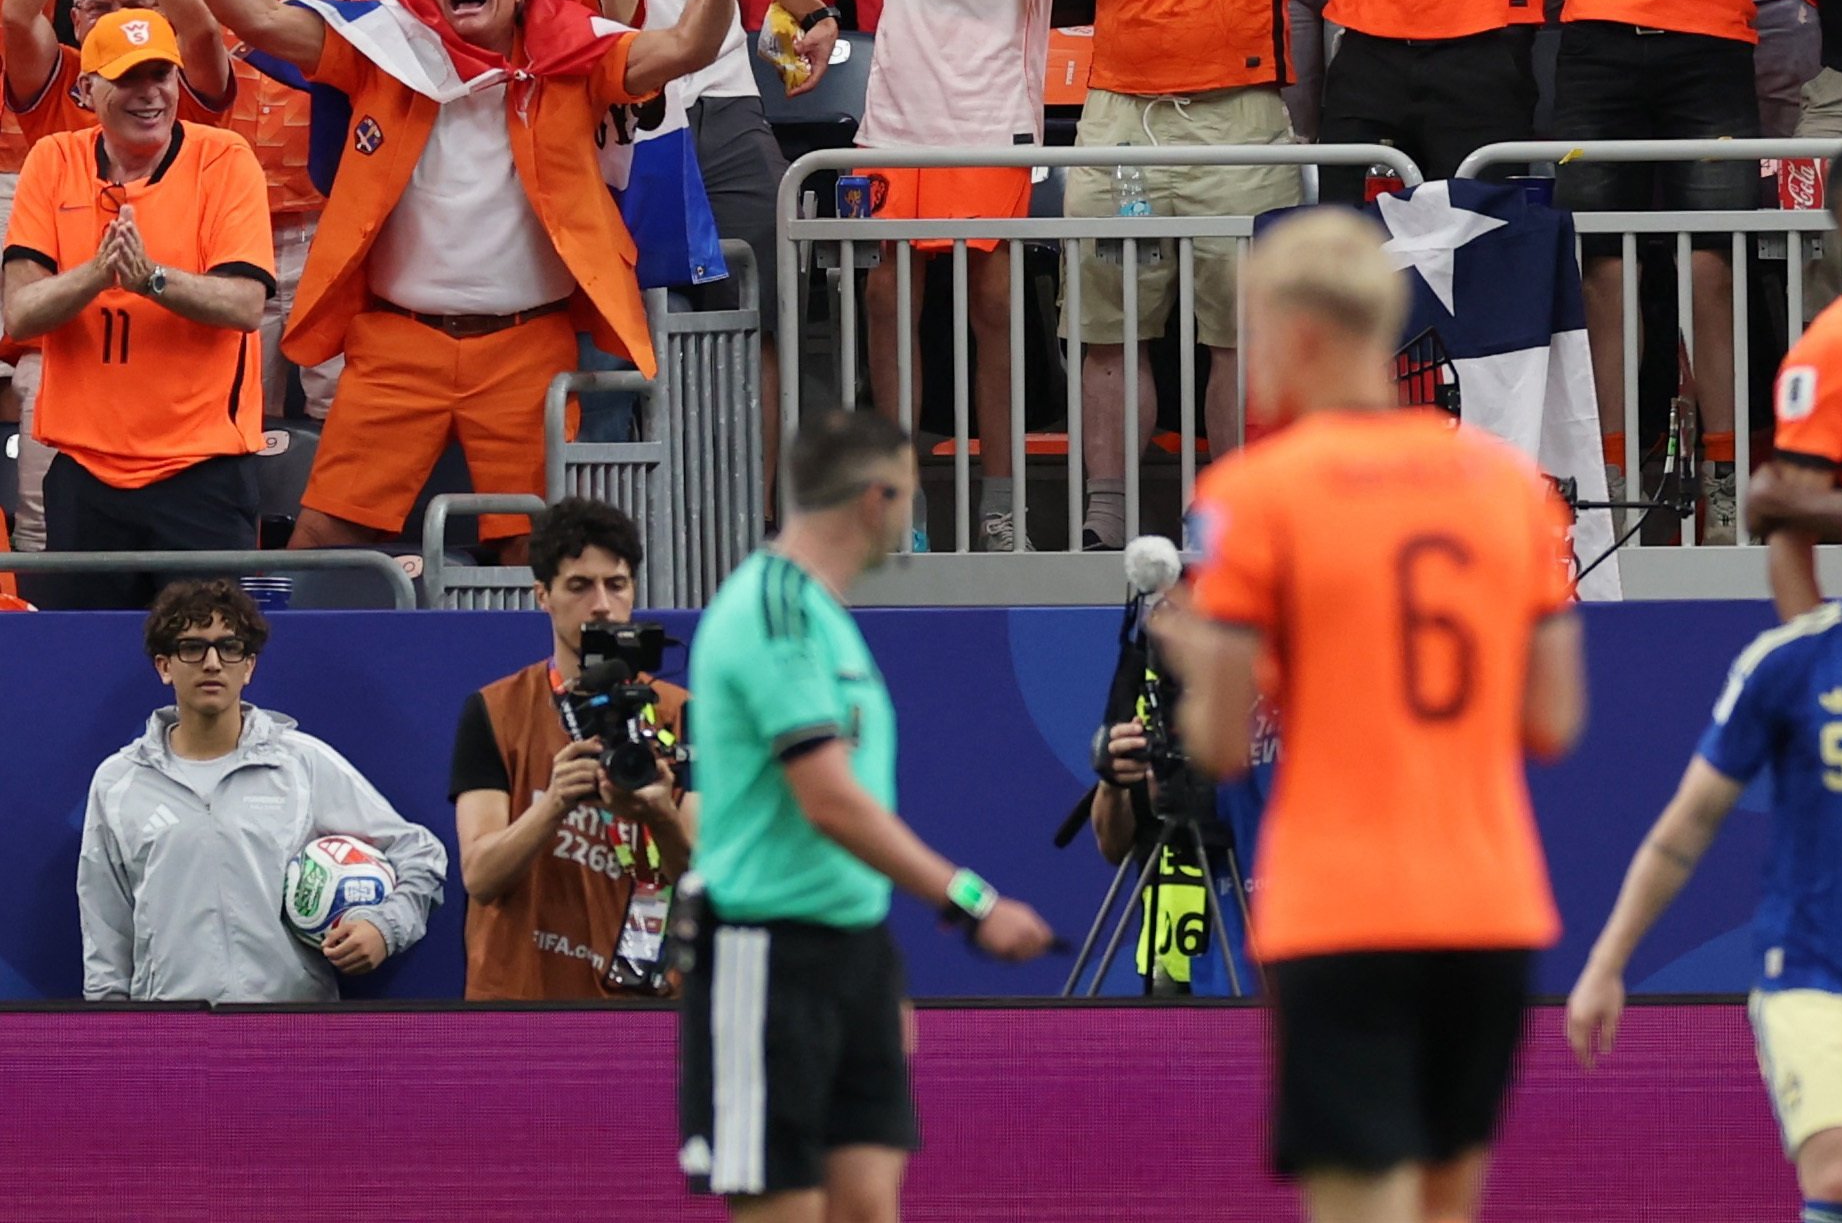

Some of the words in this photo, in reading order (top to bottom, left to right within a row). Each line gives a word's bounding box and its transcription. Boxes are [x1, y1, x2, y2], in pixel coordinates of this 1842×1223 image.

[126, 23, 145, 32] W
[132, 32, 145, 42] S
[100, 307, 131, 365] 11
[1394, 532, 1479, 725] 6
